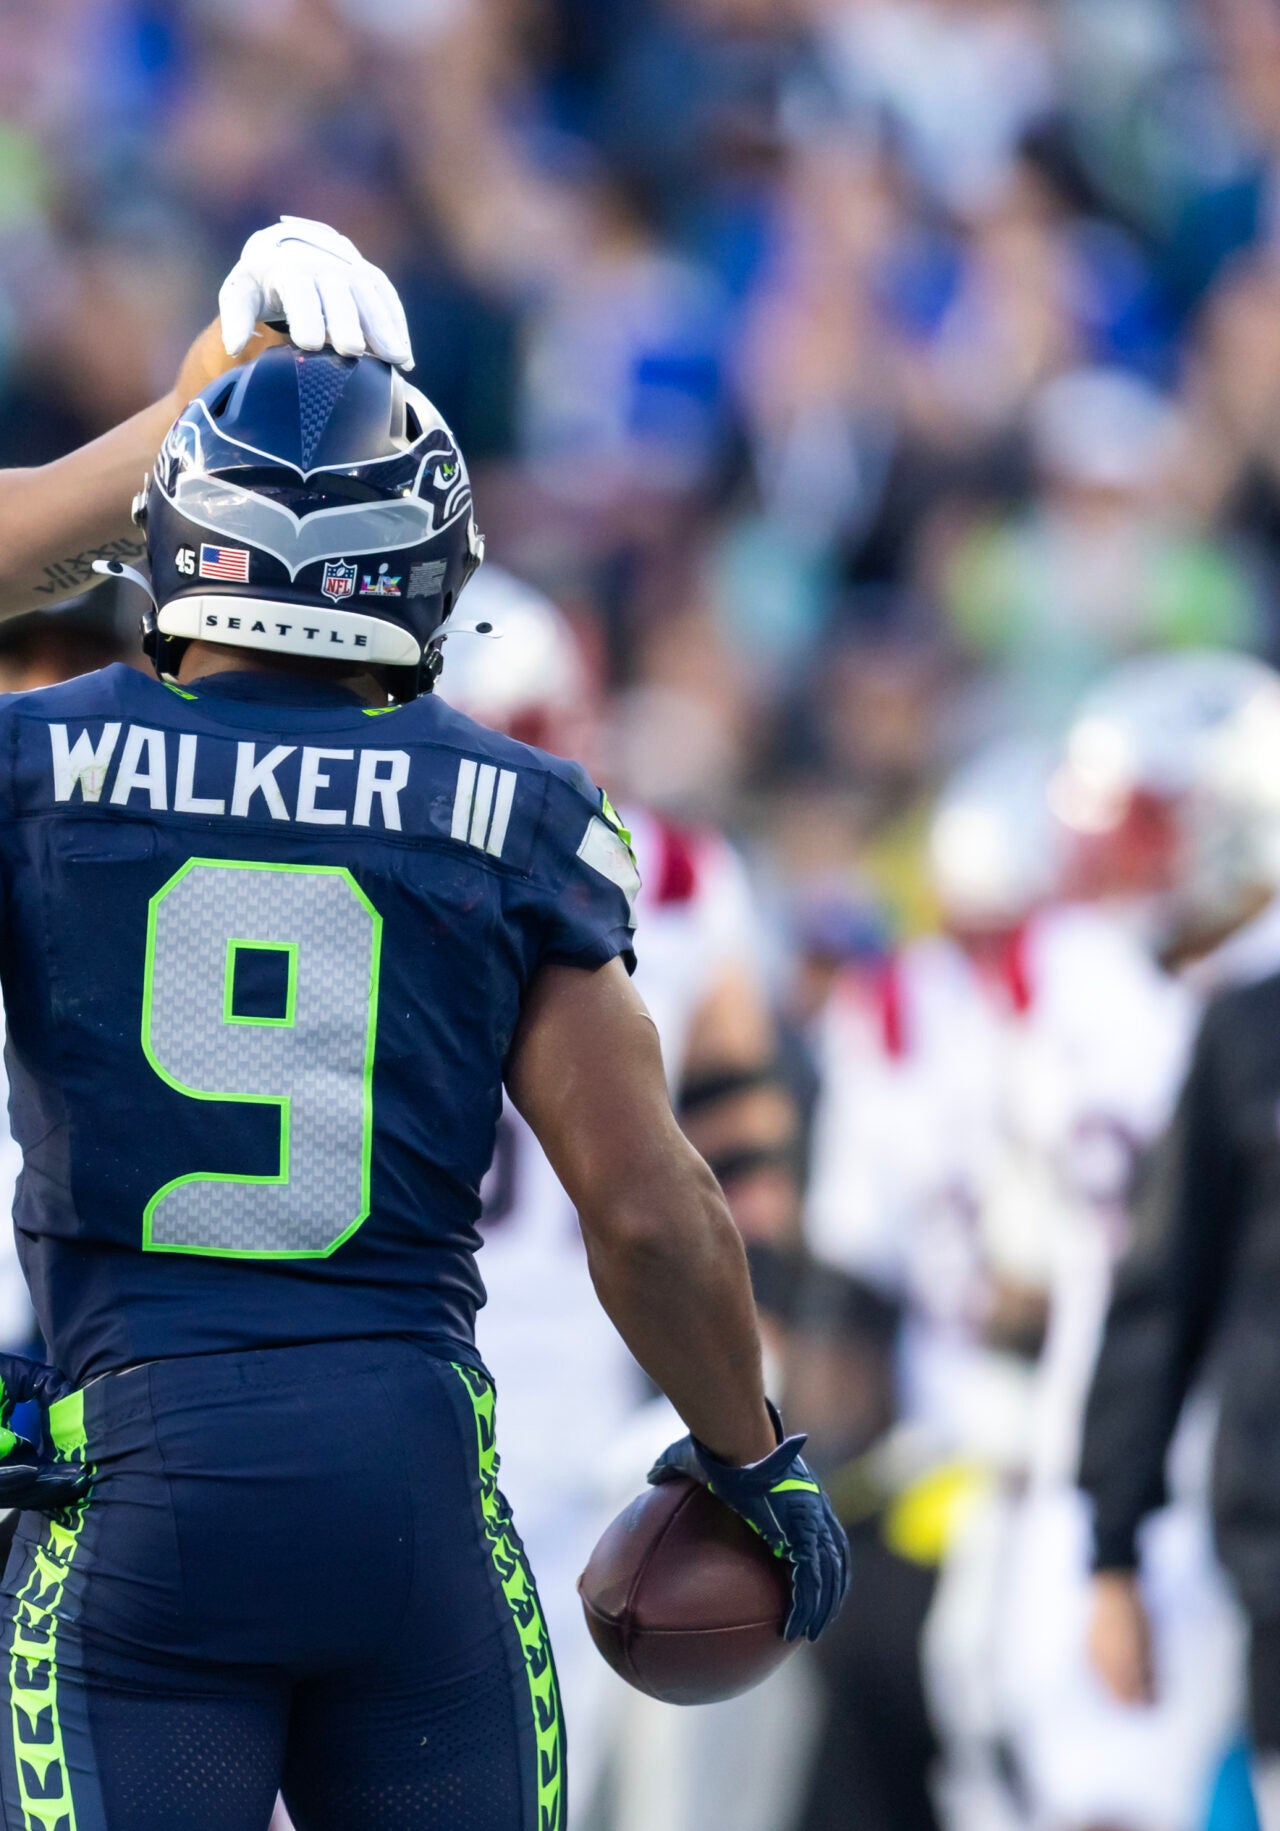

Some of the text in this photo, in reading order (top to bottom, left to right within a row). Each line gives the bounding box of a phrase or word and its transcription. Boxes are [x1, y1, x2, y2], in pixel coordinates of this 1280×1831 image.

[175, 547, 196, 575] 45
[326, 579, 350, 595] NFL
[206, 615, 368, 647] SEATTLE
[48, 722, 517, 857] WALKER III
[140, 856, 383, 1259] 9
